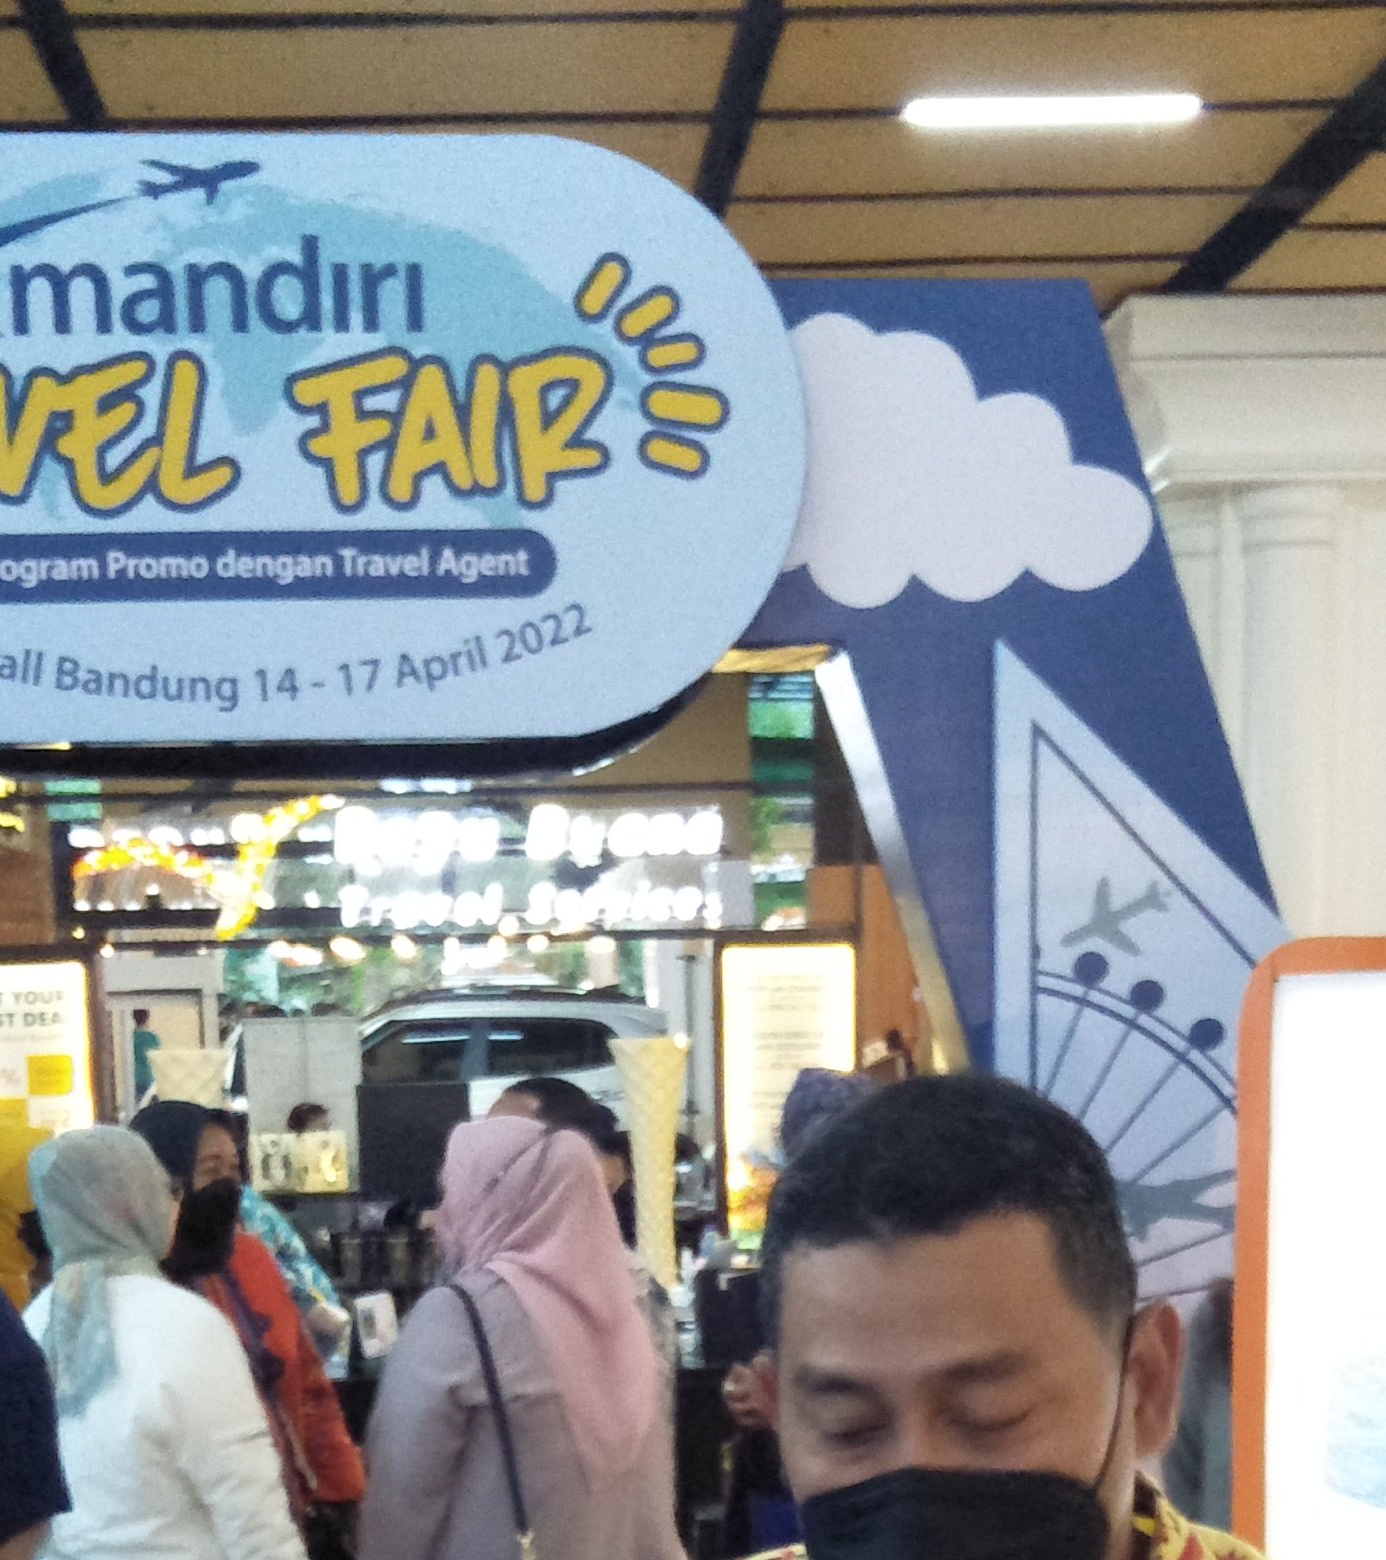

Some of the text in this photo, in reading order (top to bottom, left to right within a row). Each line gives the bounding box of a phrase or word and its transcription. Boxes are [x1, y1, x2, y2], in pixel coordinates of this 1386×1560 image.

[8, 236, 424, 335] mandiri
[287, 344, 611, 516] FAIR
[106, 550, 209, 580] Promo
[216, 548, 333, 585] dengan
[338, 547, 430, 577] Travel
[436, 547, 531, 584] Agent
[54, 655, 240, 713] Bandung
[254, 666, 300, 703] 14
[337, 657, 381, 697] 17
[394, 635, 488, 692] April
[495, 602, 594, 665] 2022
[22, 1011, 68, 1028] DEA
